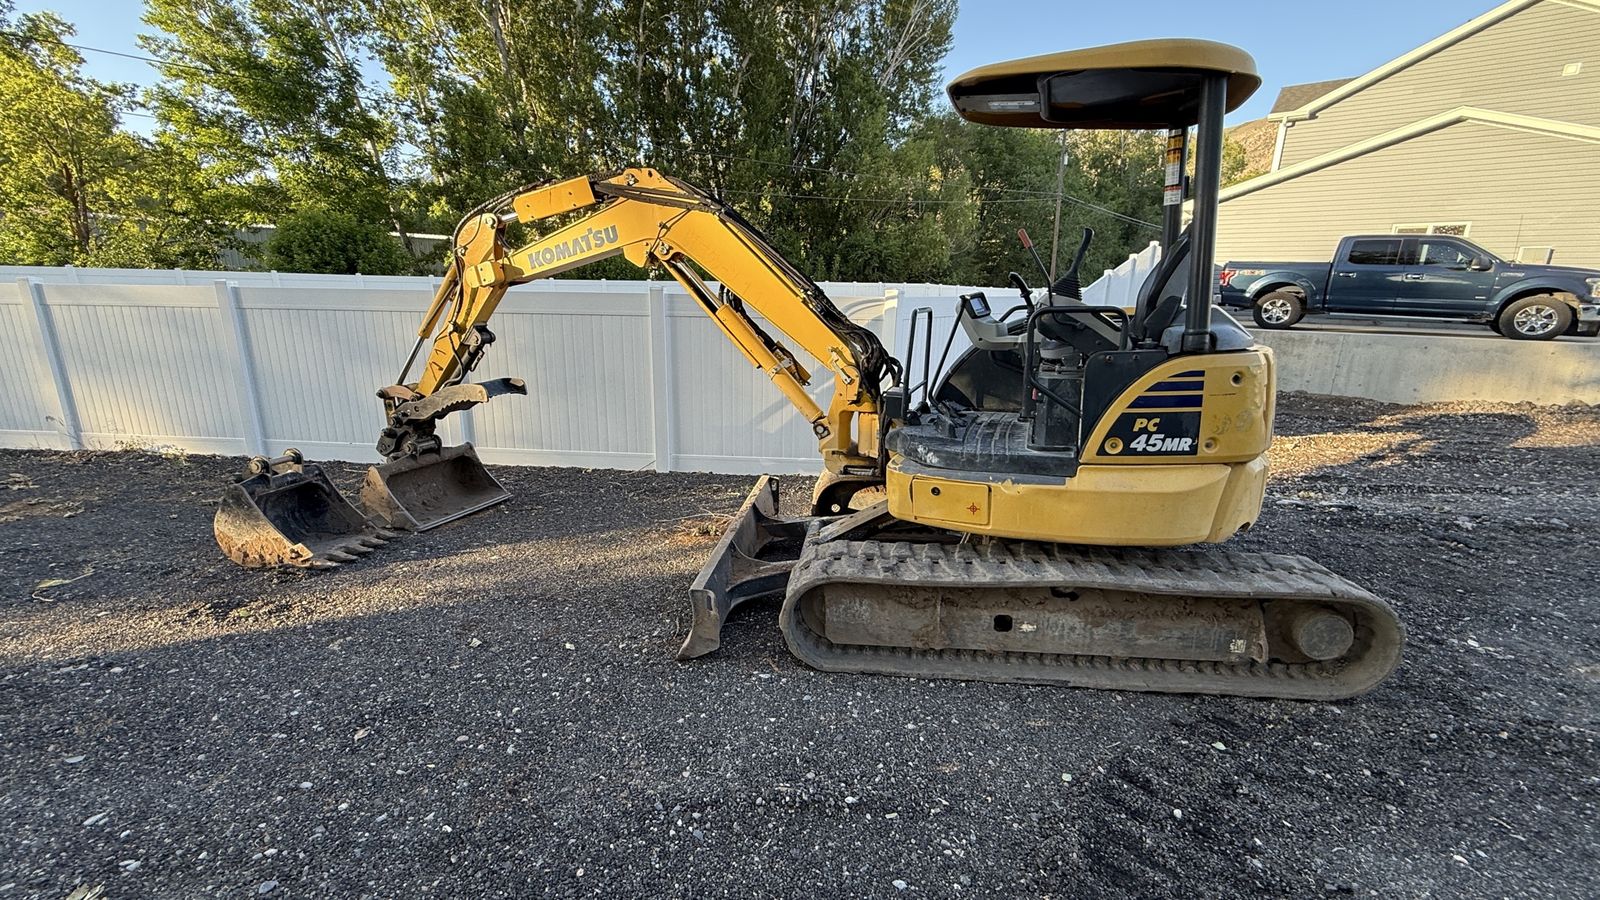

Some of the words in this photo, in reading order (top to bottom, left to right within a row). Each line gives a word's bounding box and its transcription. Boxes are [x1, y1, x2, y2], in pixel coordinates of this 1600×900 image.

[528, 225, 618, 269] KOMATSU
[1132, 417, 1160, 432] PC
[1129, 433, 1193, 452] 45MR
